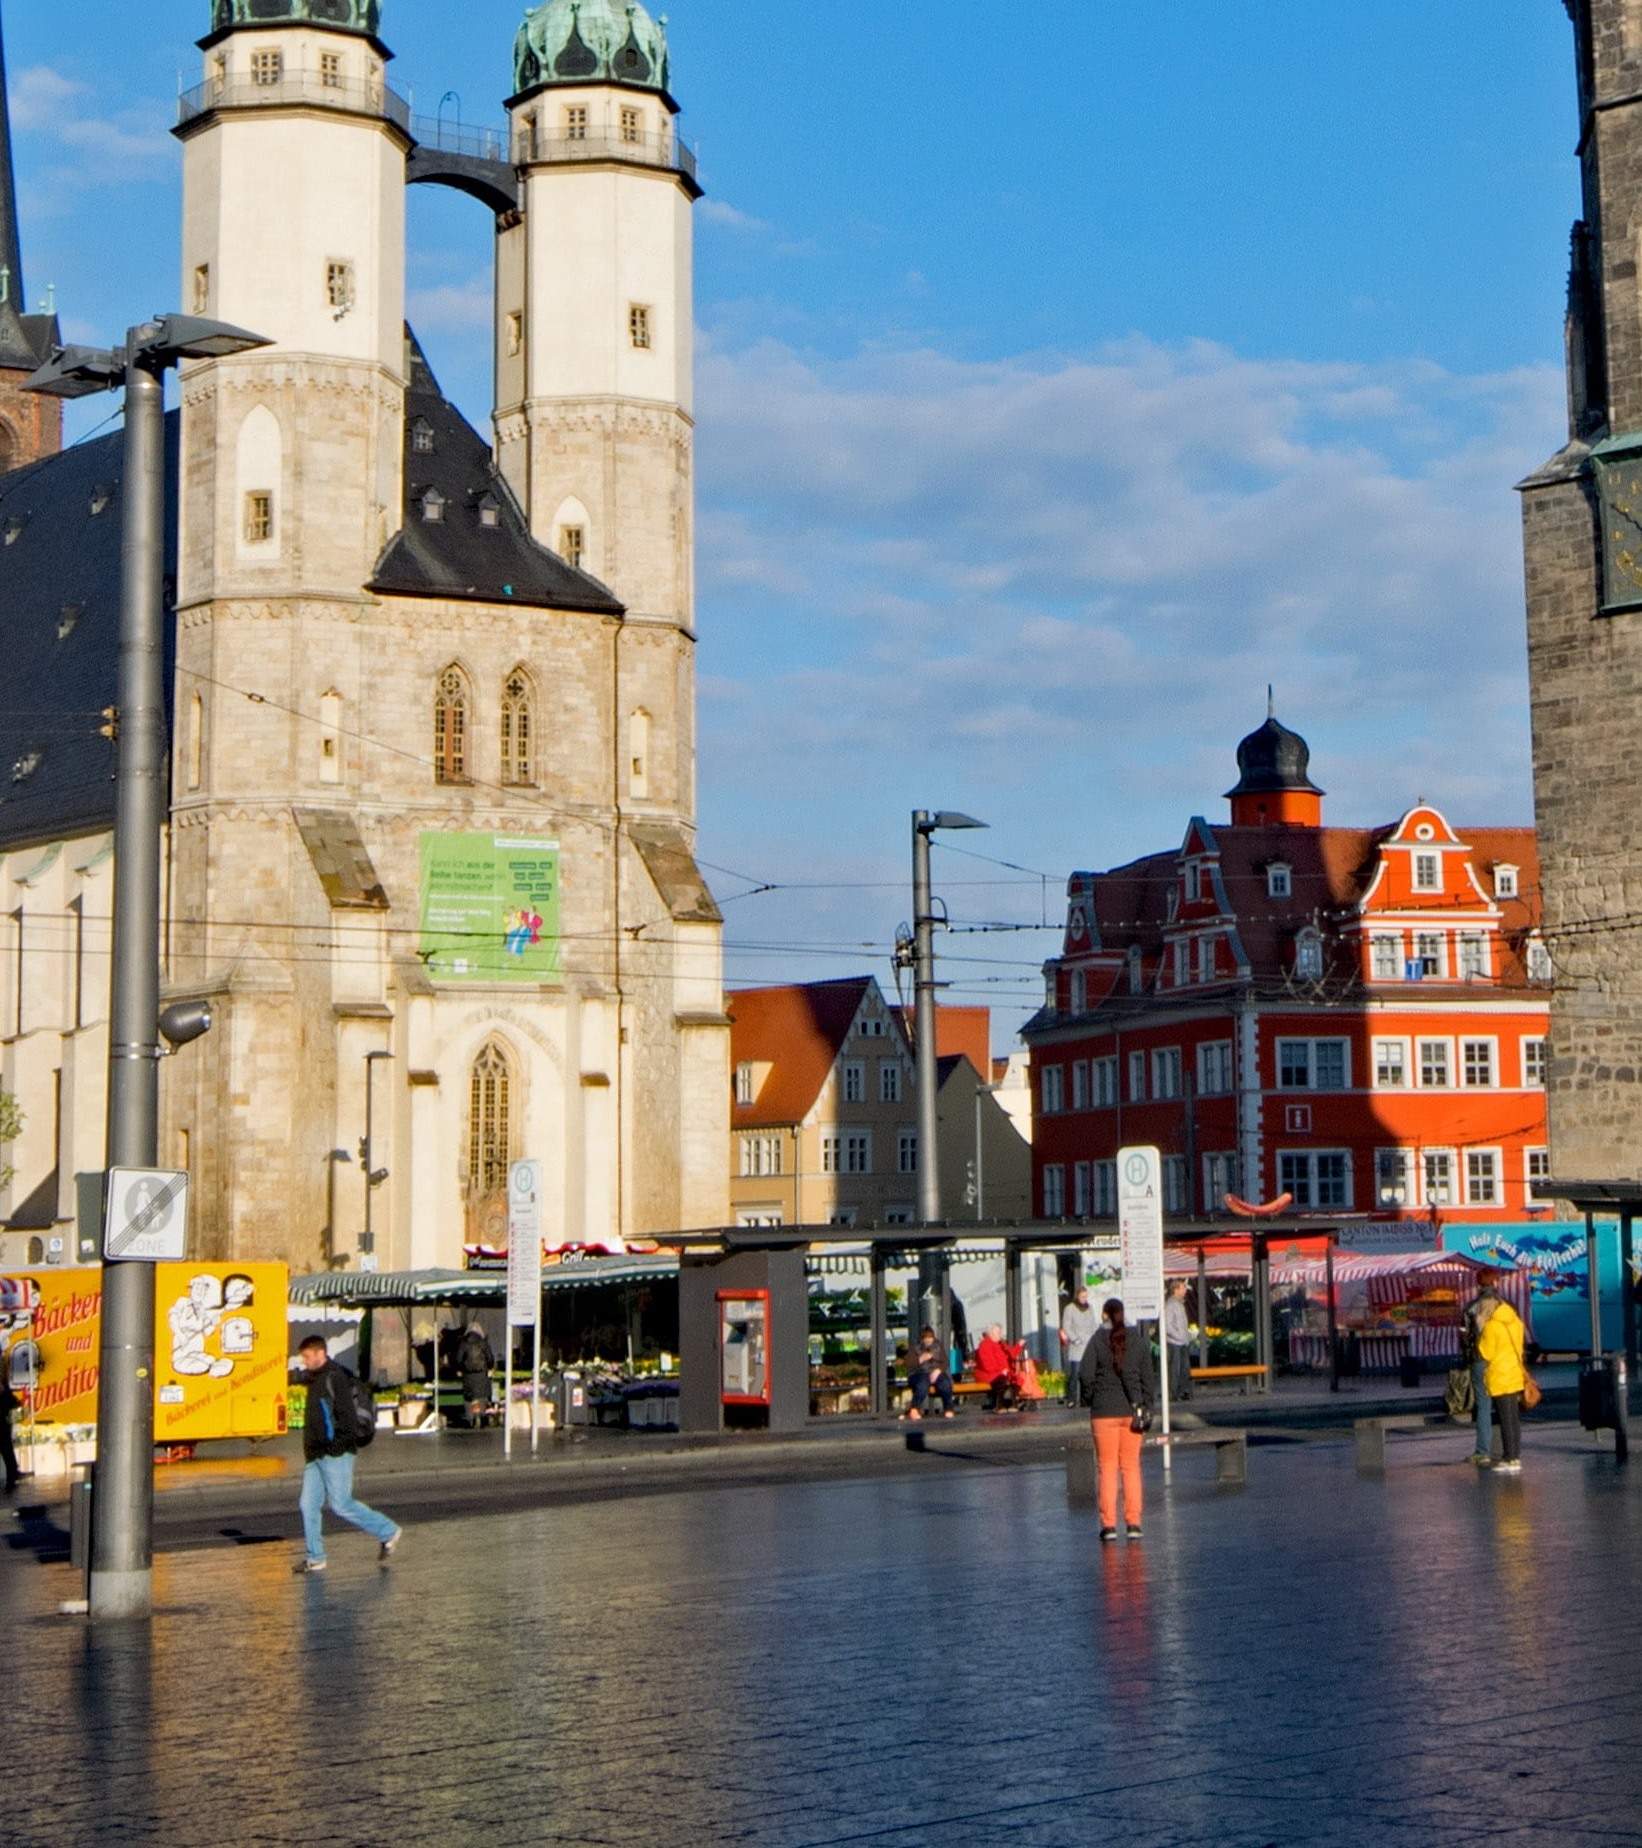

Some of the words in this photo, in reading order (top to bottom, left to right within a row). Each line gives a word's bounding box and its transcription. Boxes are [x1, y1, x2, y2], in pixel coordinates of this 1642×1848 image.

[1145, 1184, 1154, 1198] A
[128, 1239, 166, 1253] ZONE
[1469, 1231, 1491, 1251] Holt
[1494, 1233, 1518, 1259] Euch
[561, 1249, 584, 1265] Grill
[66, 1330, 94, 1353] und
[165, 1391, 211, 1426] Bäckerei
[229, 1352, 283, 1392] Konditorei
